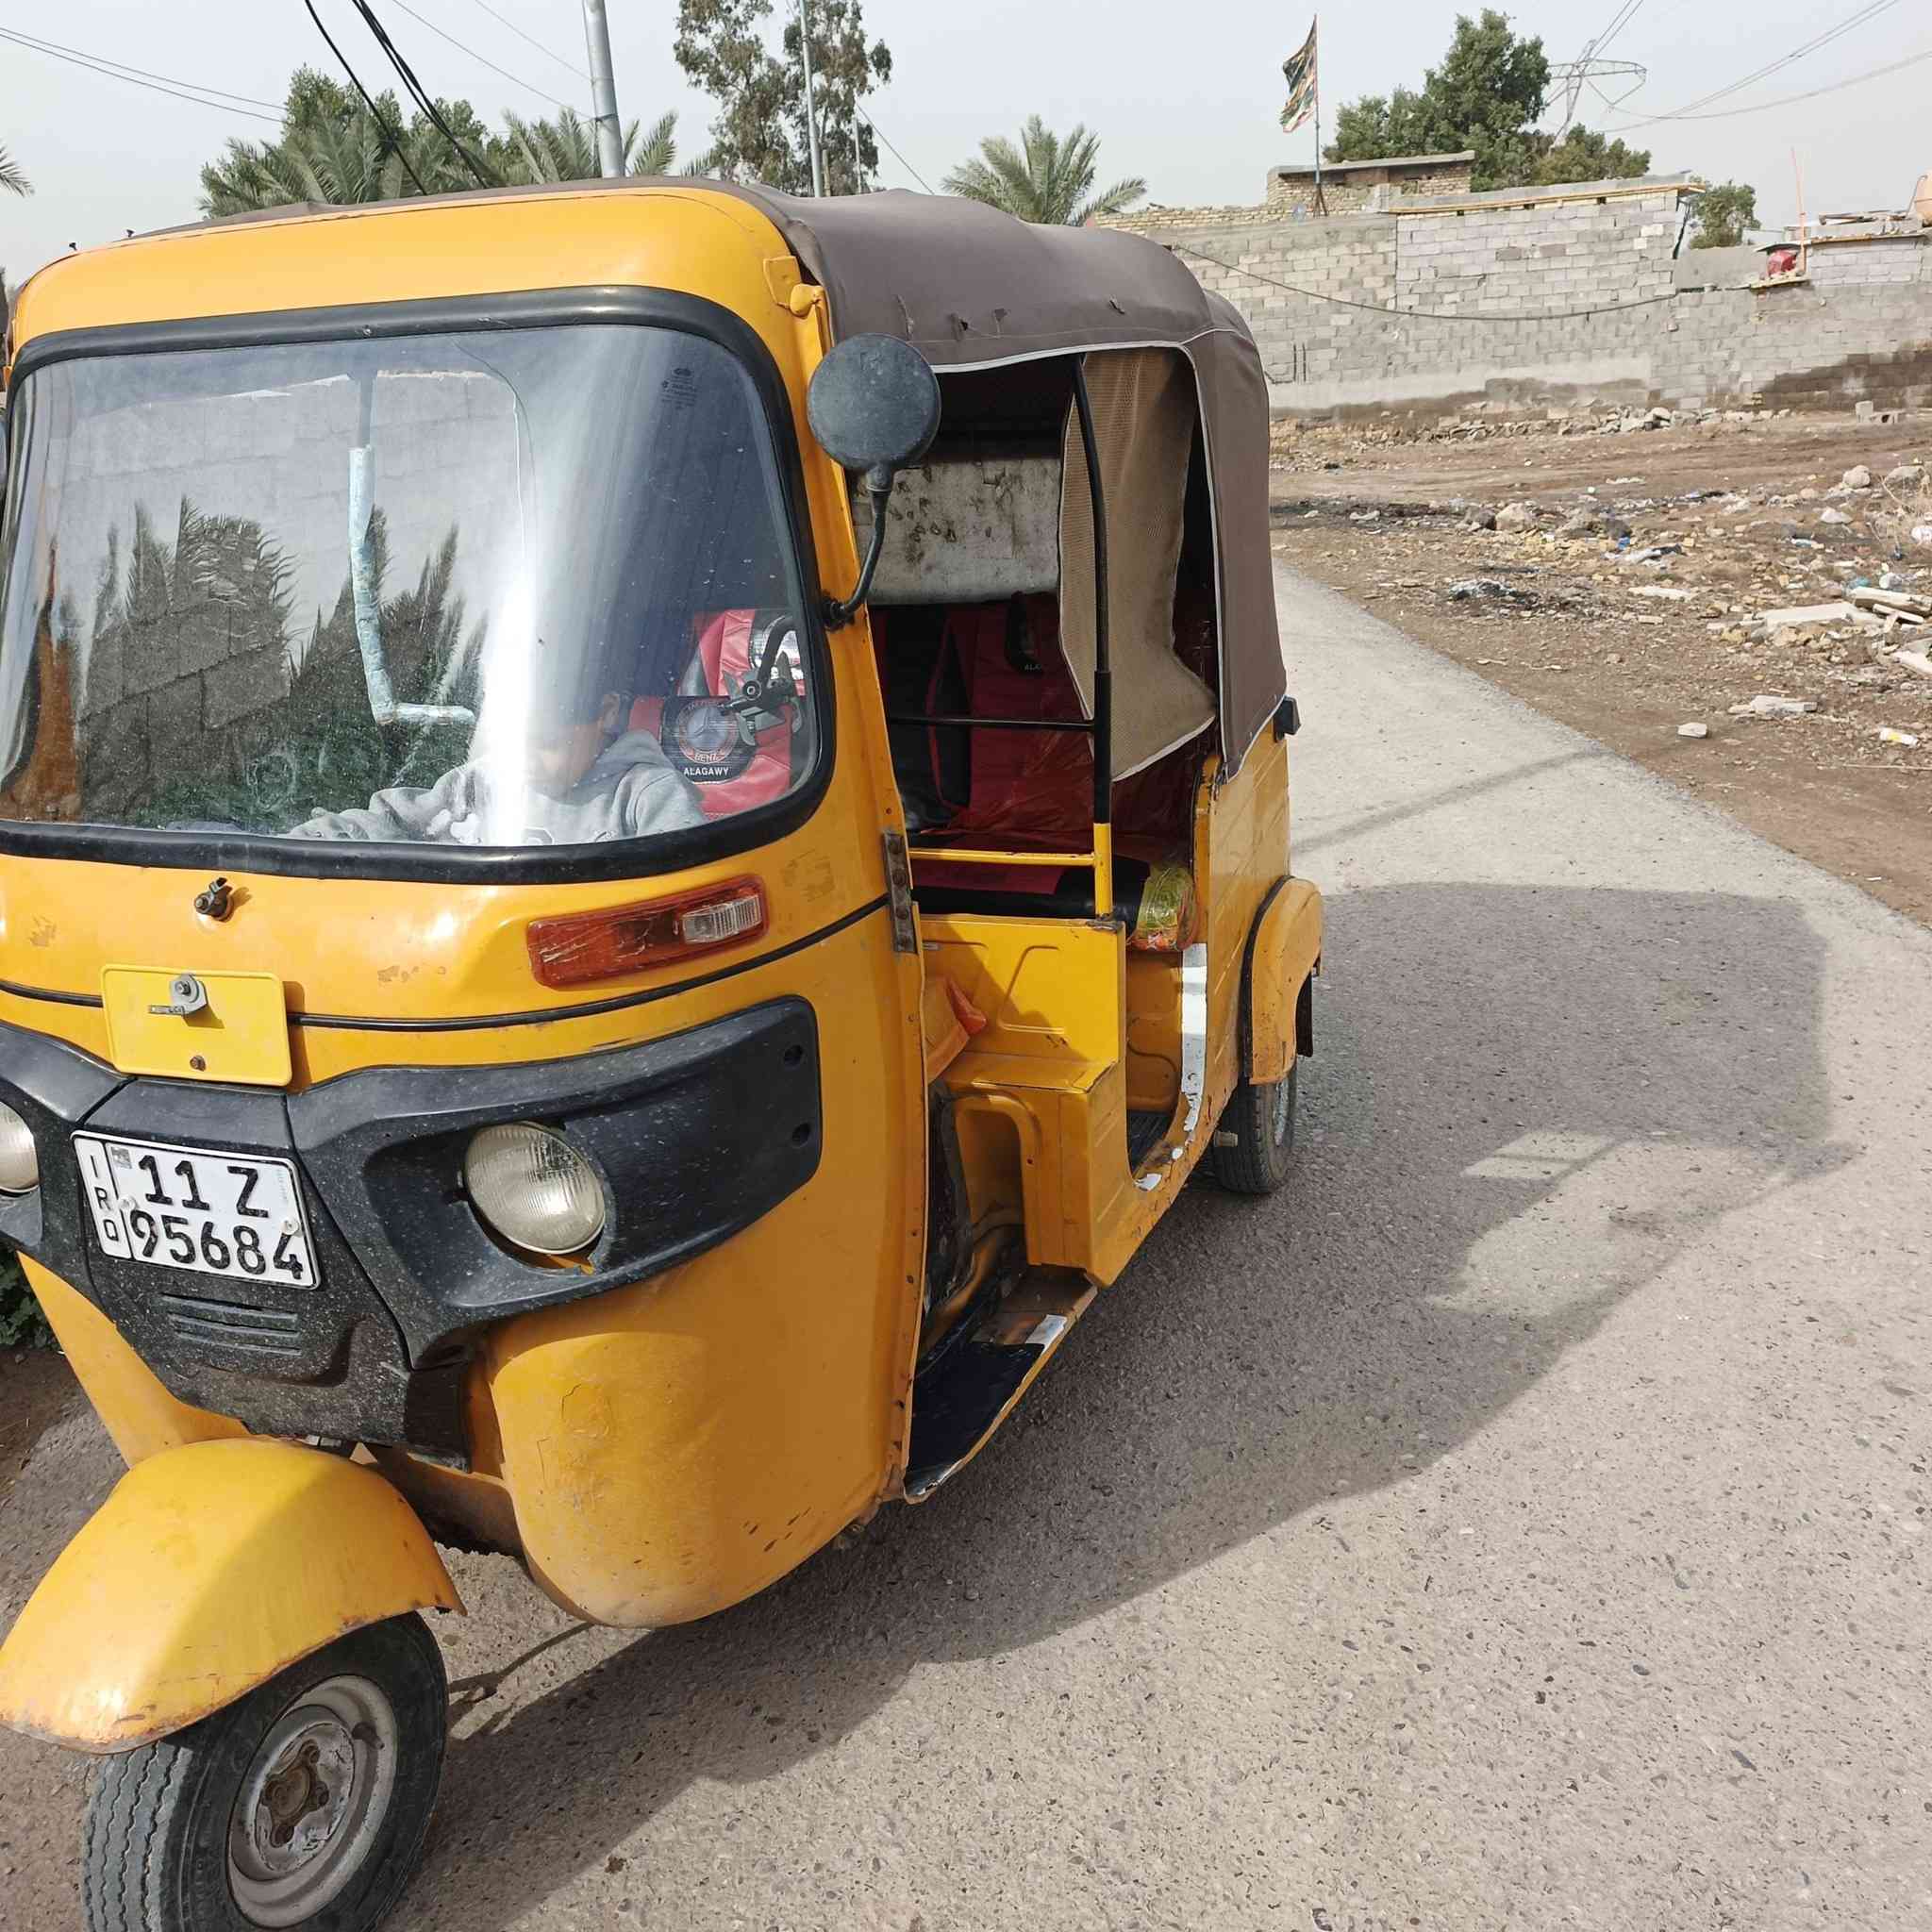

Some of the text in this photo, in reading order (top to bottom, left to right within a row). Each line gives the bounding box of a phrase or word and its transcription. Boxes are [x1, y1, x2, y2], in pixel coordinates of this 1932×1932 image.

[683, 767, 729, 776] ALAGAWY
[138, 1155, 269, 1218] 11 Z
[130, 1209, 303, 1280] 95684
